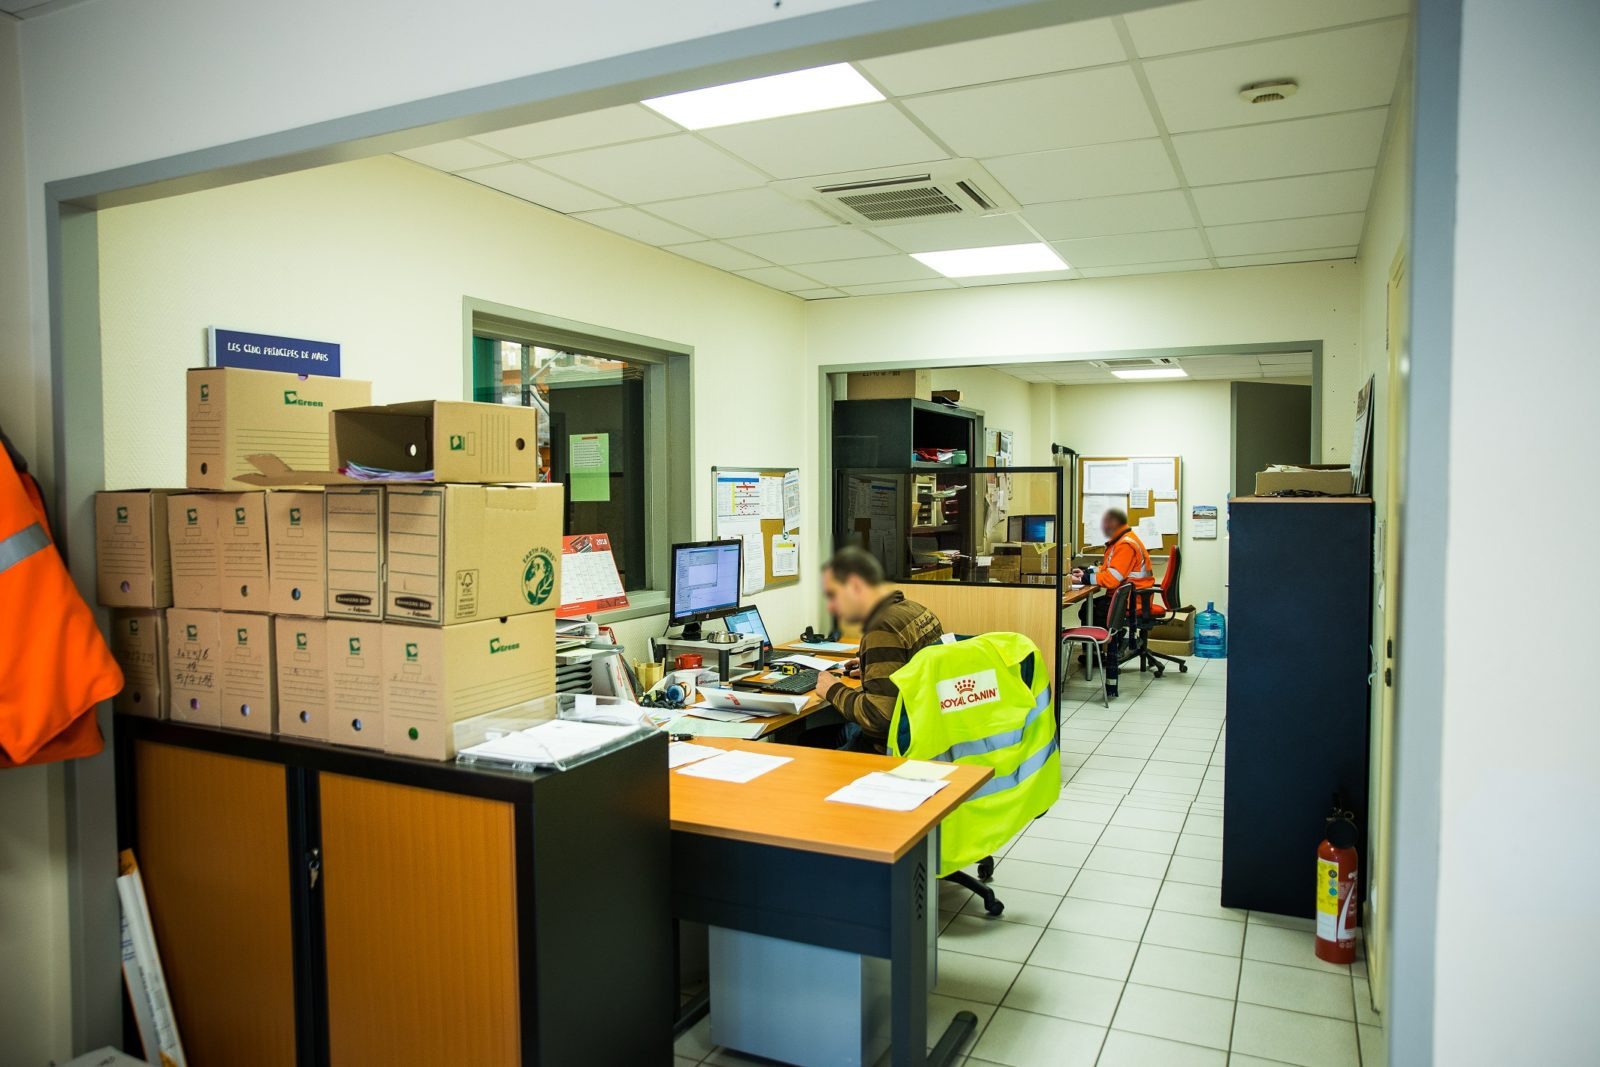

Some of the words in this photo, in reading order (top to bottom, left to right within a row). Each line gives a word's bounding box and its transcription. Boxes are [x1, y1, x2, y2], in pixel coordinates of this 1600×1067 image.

[227, 342, 241, 352] LES
[243, 344, 261, 355] CINQ
[263, 347, 299, 358] PRINCIPES
[301, 350, 309, 359] DE
[311, 352, 329, 362] MARS
[298, 398, 324, 408] Green
[522, 547, 539, 564] EARTH
[540, 546, 555, 562] SERIES
[499, 642, 521, 653] Green
[967, 689, 996, 703] CANIN
